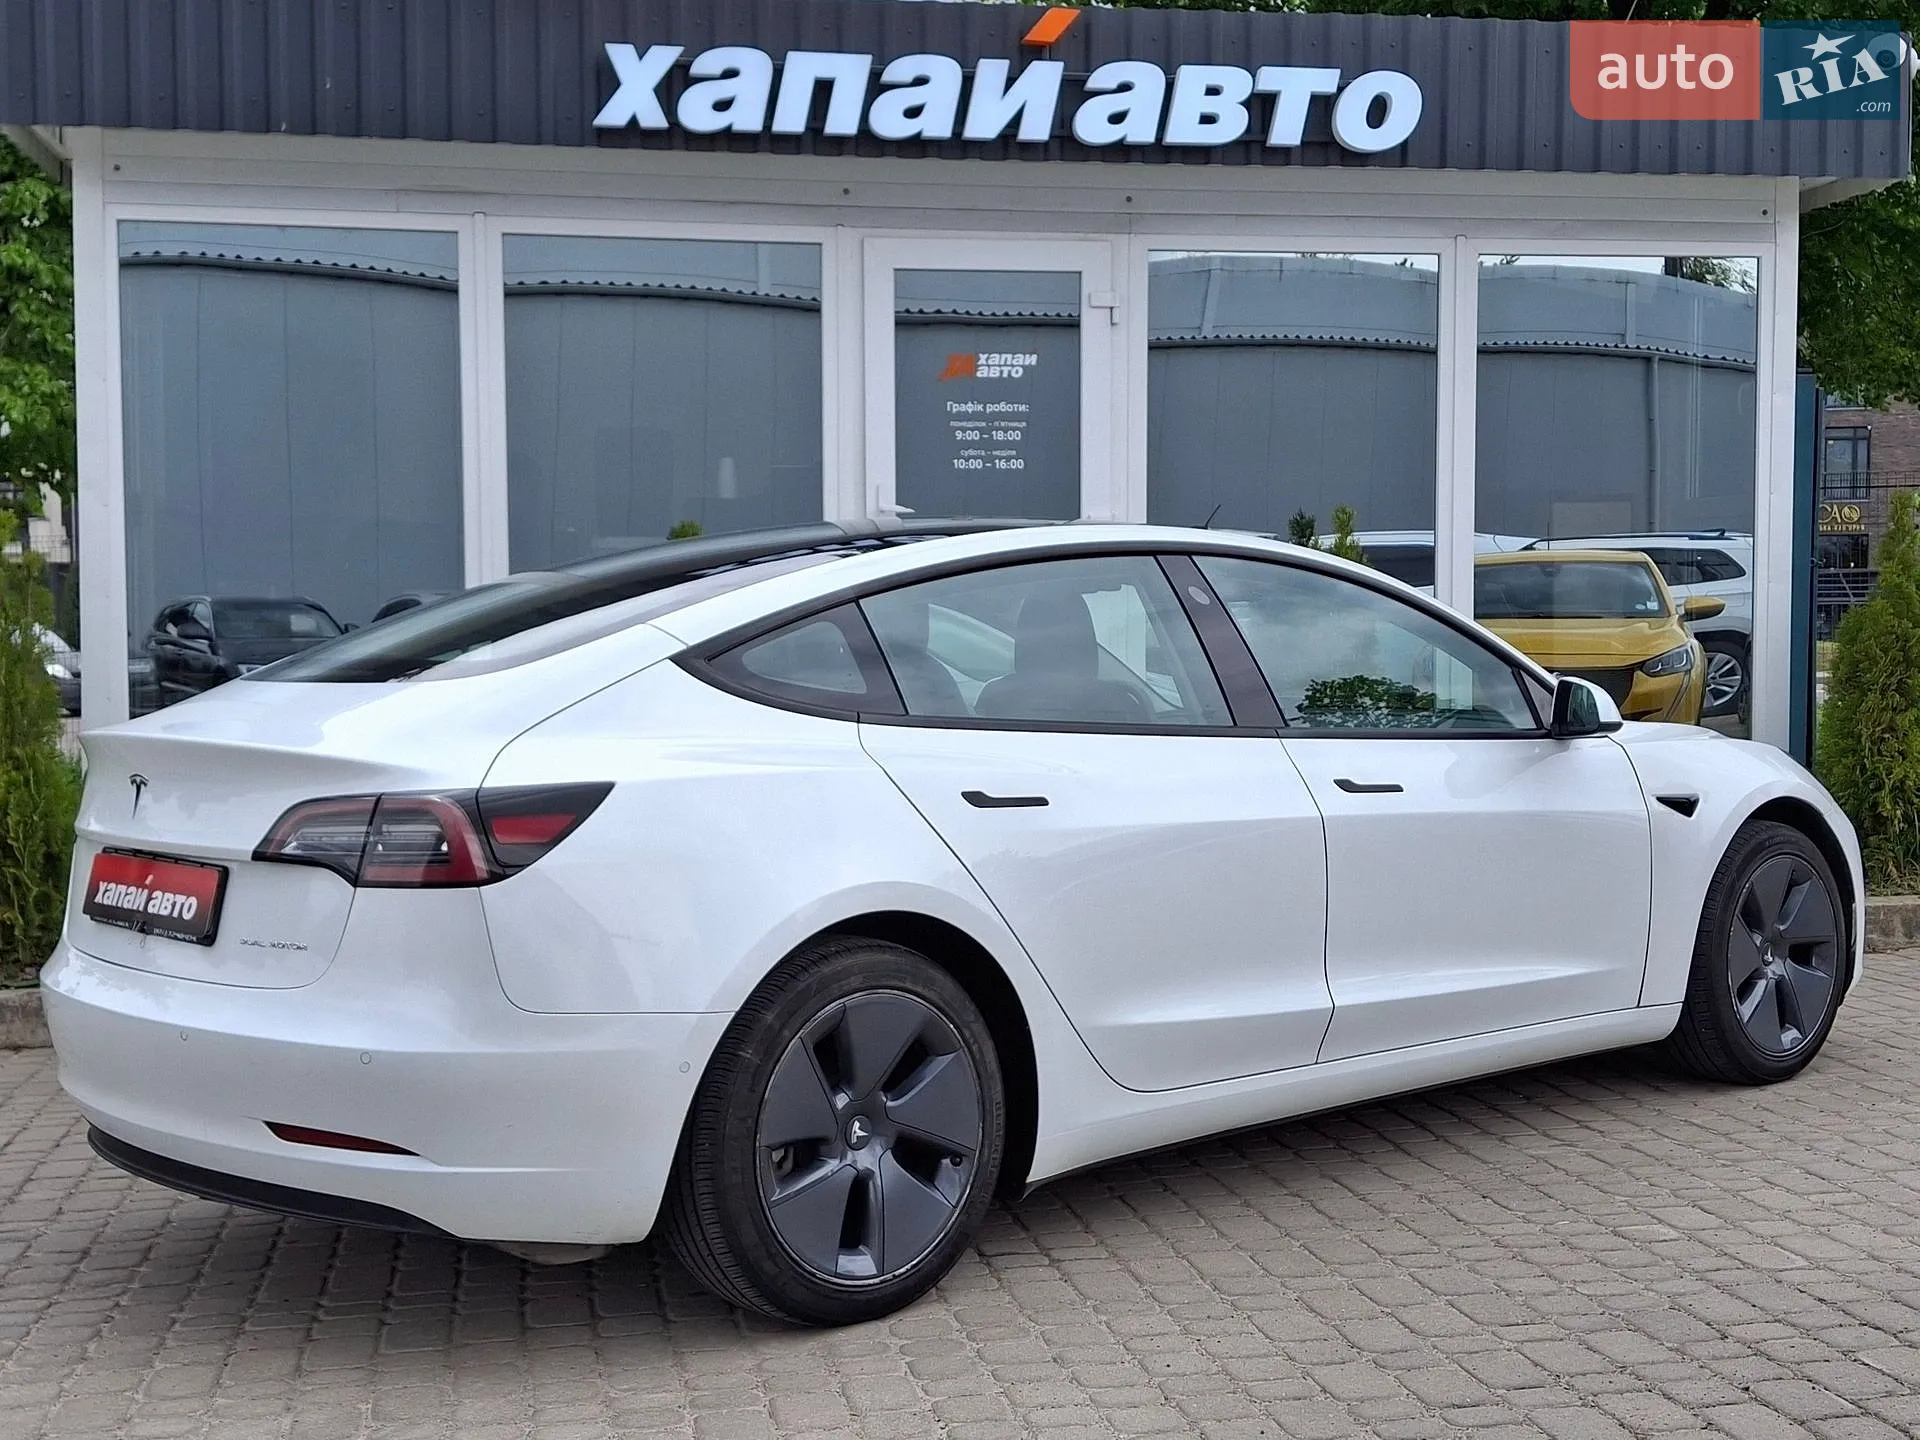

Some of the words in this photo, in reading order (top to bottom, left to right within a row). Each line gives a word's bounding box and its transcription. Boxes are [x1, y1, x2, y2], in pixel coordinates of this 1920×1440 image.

[1072, 60, 1424, 153] авто
[976, 366, 1023, 378] авто
[946, 401, 984, 413] Графік
[986, 402, 1029, 413] роботи:
[955, 430, 979, 440] 9:00
[992, 430, 1021, 440] 18:00
[953, 459, 983, 469] 10:00
[994, 459, 1025, 469] 16:00
[147, 889, 199, 921] авто
